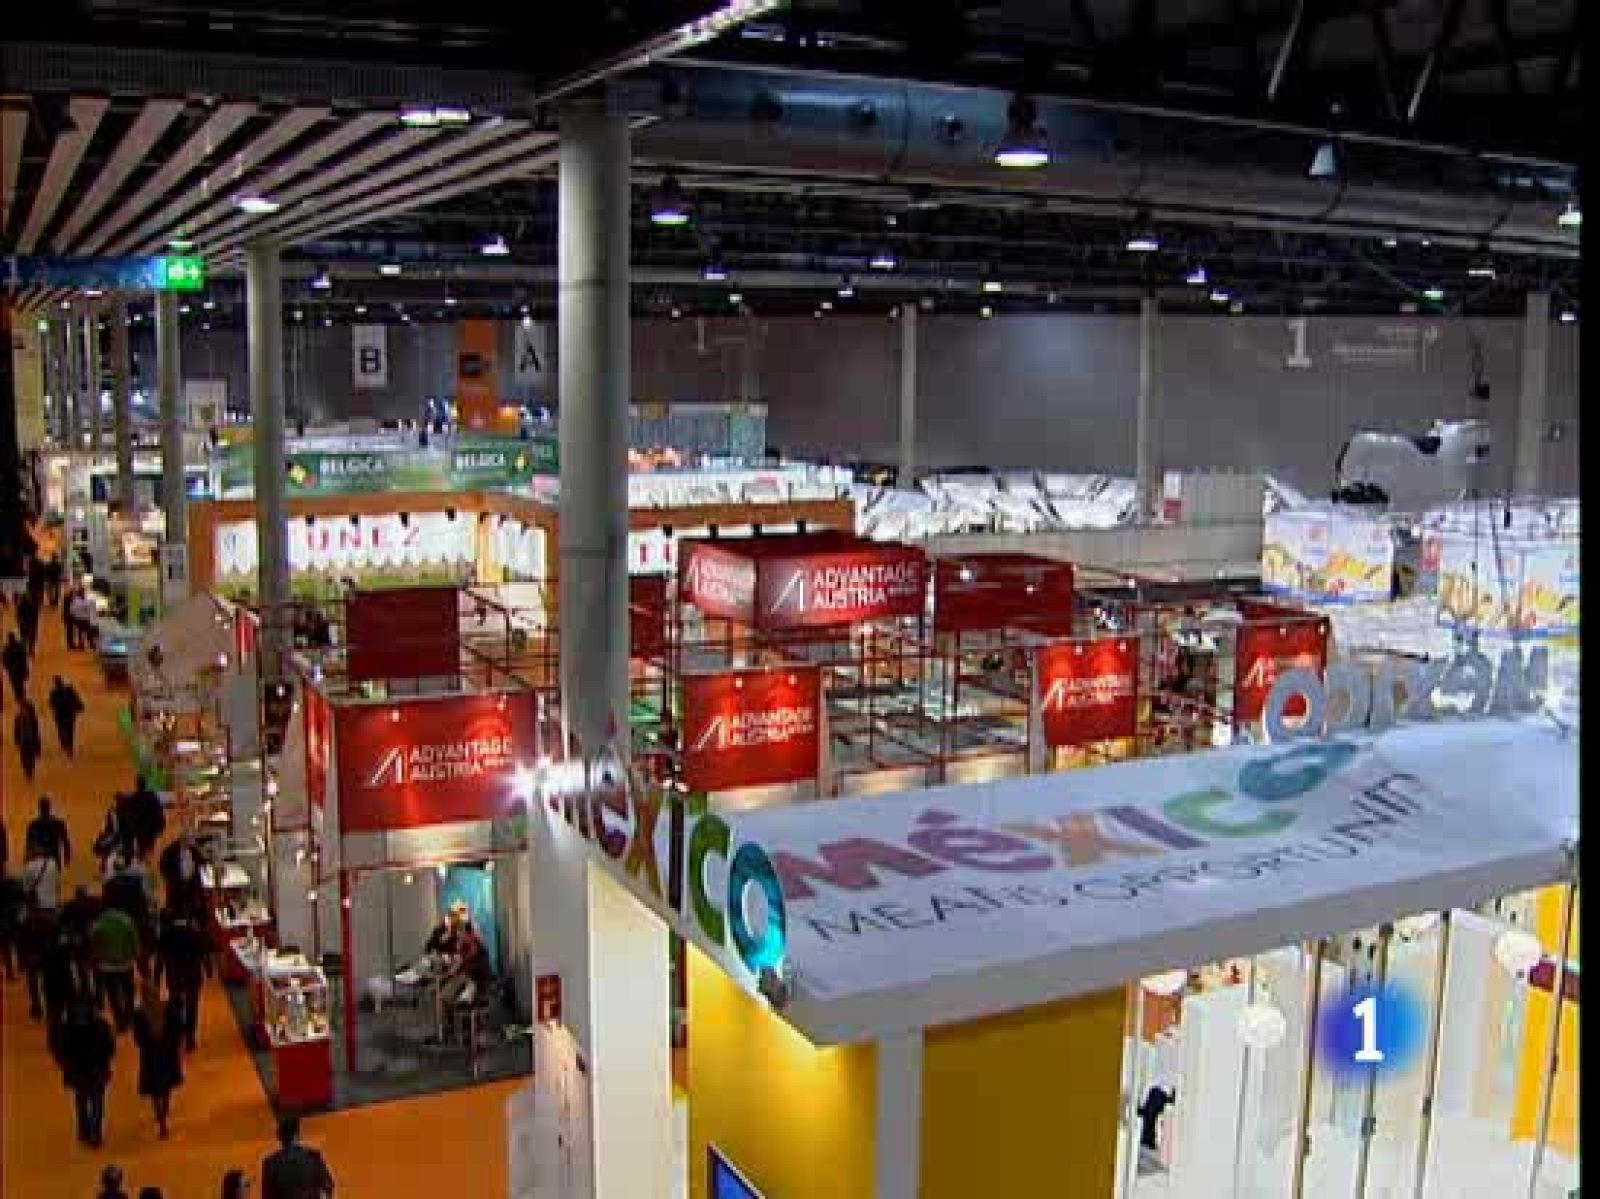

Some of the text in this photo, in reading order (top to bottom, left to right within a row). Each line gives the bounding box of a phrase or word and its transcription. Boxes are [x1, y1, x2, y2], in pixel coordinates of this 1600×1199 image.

[360, 348, 381, 373] B
[520, 342, 541, 372] A
[305, 526, 420, 551] UNEZ
[812, 561, 920, 590] ADVANTAGE
[812, 587, 887, 611] AUSTRIA
[409, 736, 512, 765] ADVANTAGE
[409, 760, 483, 782] AUSTRIA
